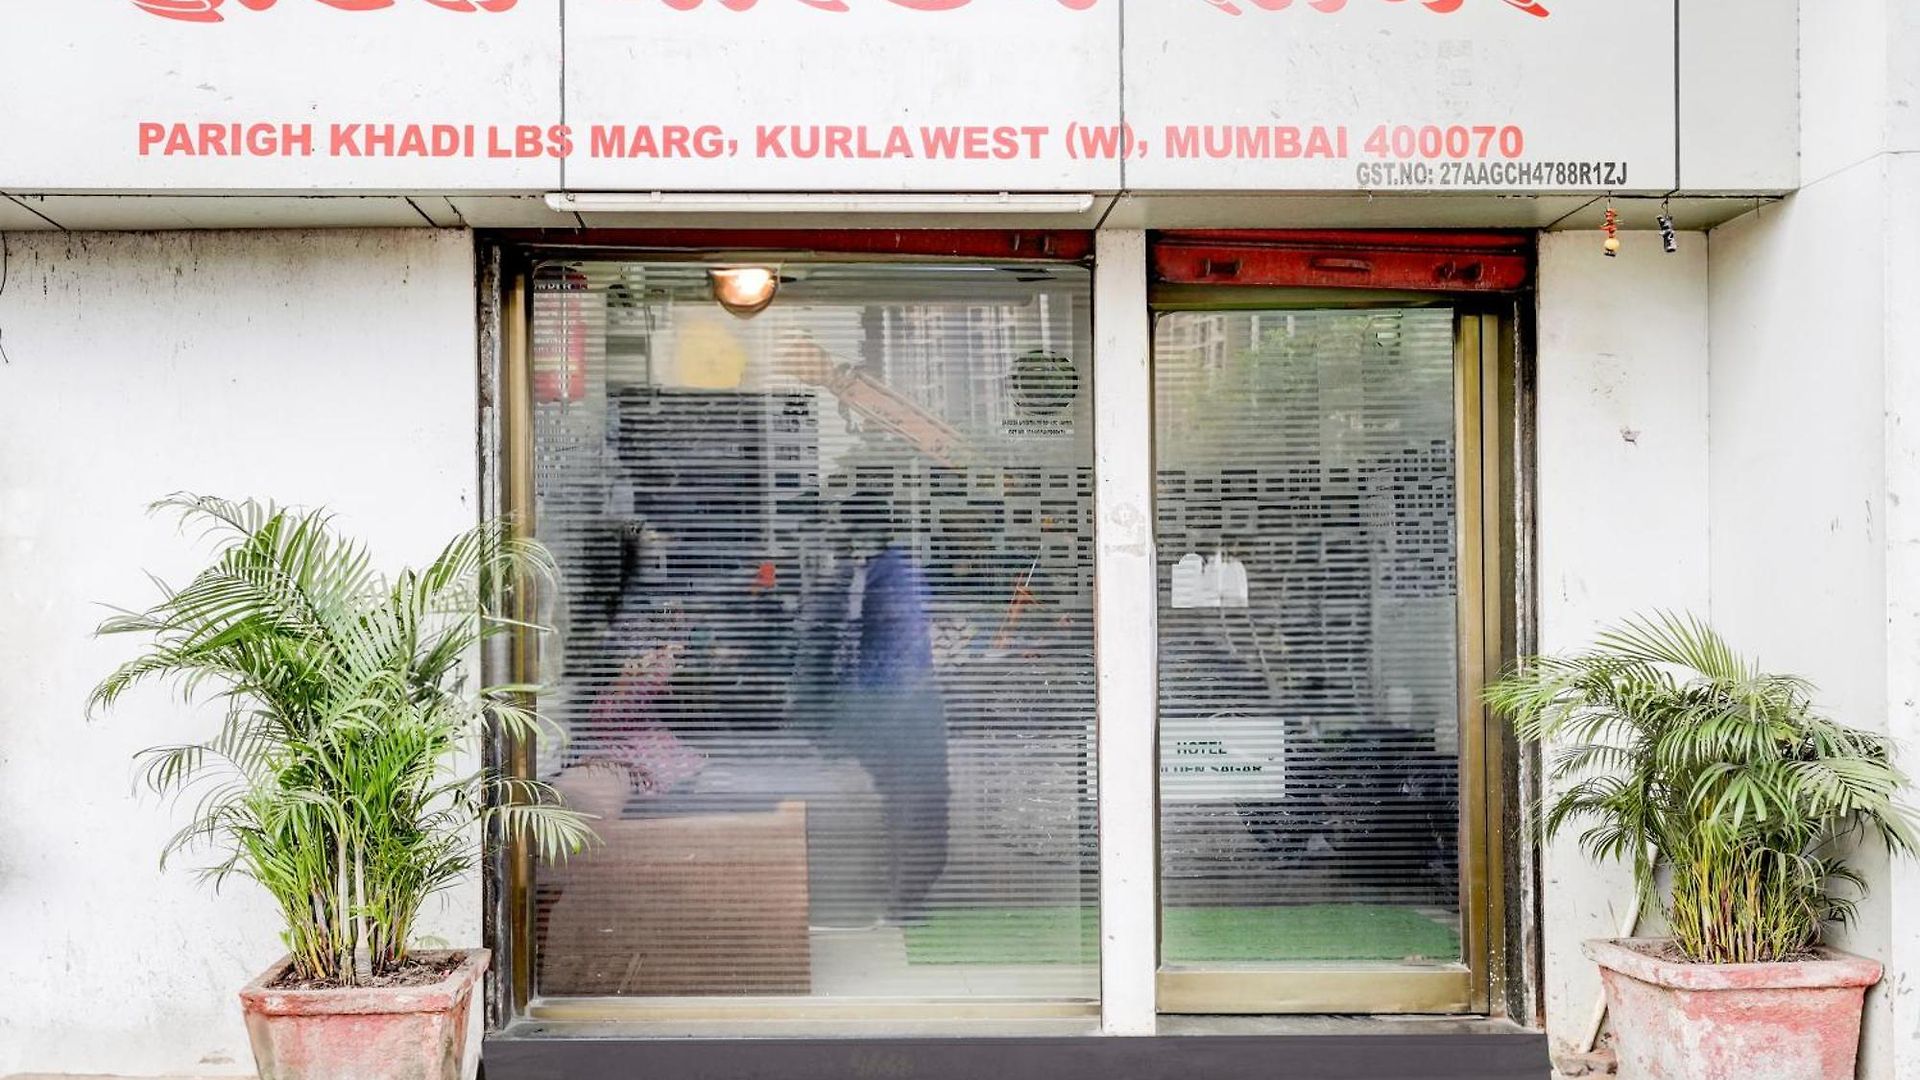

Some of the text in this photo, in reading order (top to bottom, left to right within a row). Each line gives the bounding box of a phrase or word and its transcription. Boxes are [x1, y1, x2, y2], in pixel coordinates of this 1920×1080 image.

[139, 121, 1525, 160] PARIGH KHADI LBS MARG, KURLA WEST (W), MUMBAI 400070
[1356, 162, 1627, 186] GST.NO: 27AAGCH4788R1ZJ
[1177, 741, 1228, 755] HOTEL
